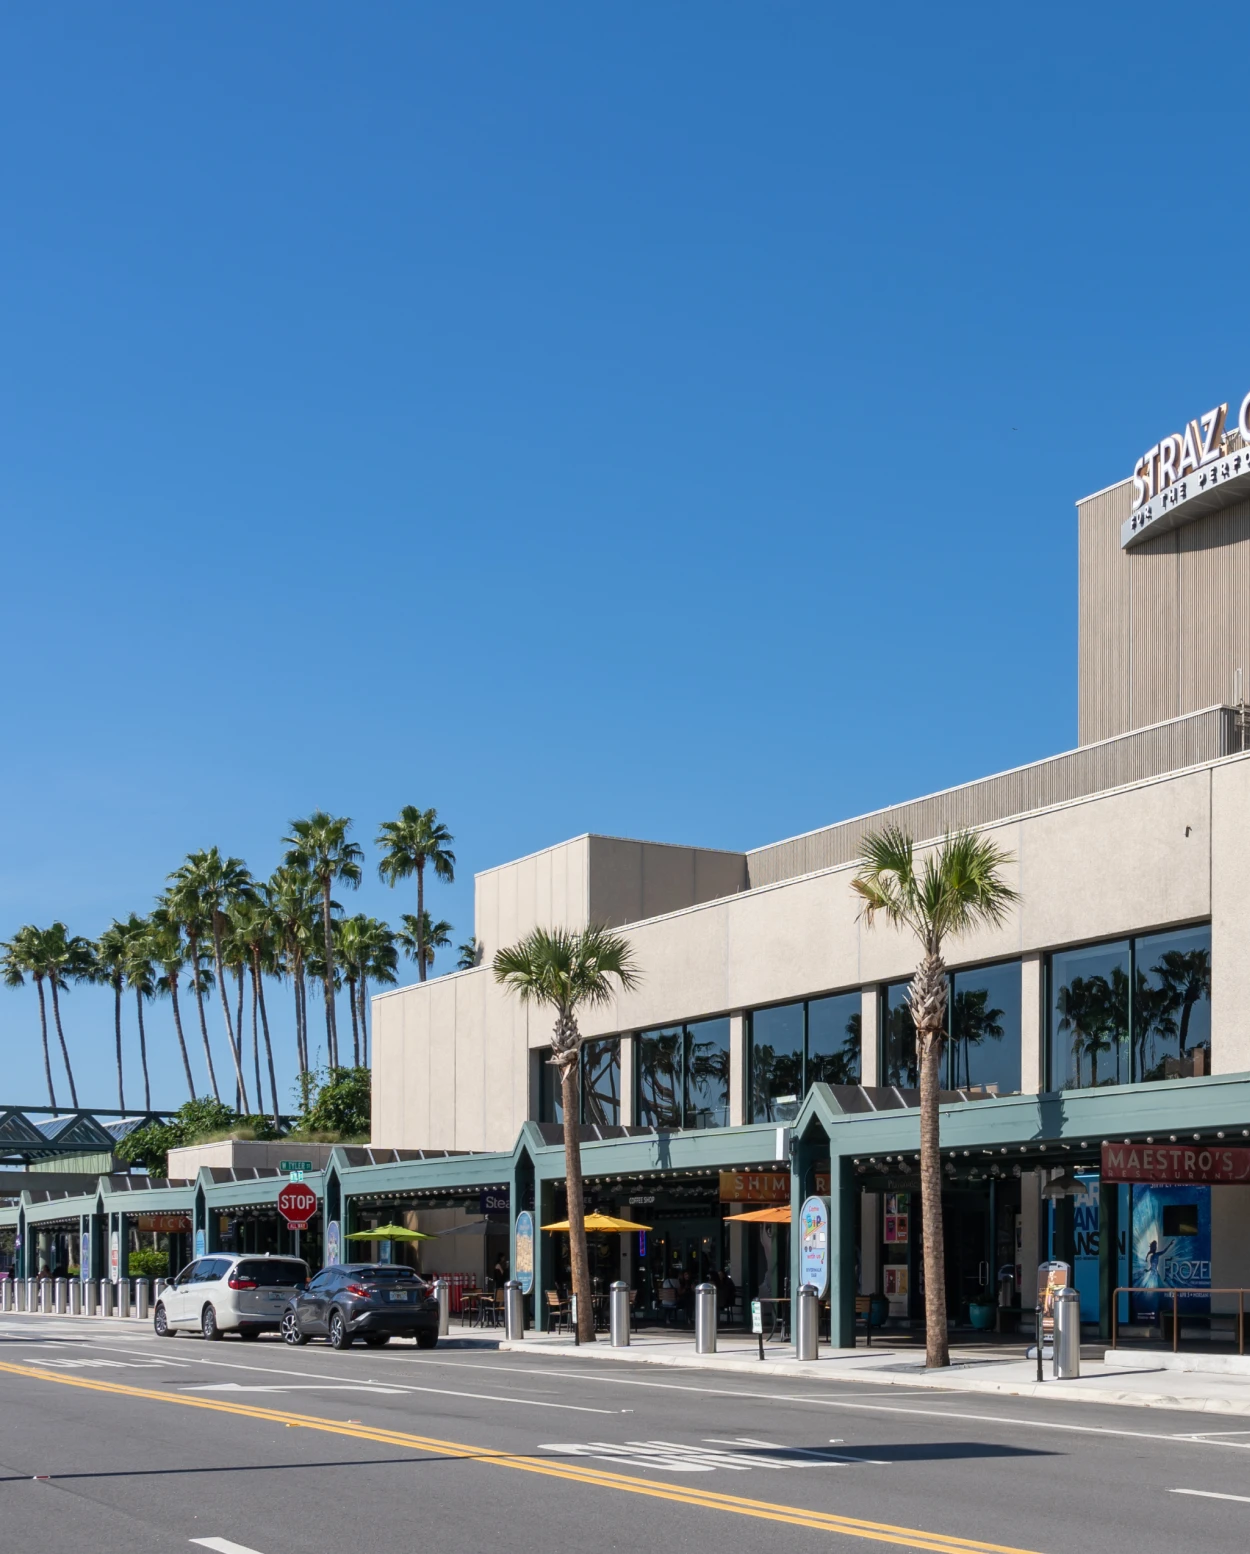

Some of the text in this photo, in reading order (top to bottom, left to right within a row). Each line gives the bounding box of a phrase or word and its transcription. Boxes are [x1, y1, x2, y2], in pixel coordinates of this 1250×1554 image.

[1132, 403, 1228, 510] STRAZ
[1130, 505, 1152, 531] FOR
[1160, 481, 1187, 507] THE
[288, 1162, 305, 1170] TYLER
[1107, 1149, 1234, 1172] MAESTRO'S
[1108, 1169, 1236, 1180] RESTAURANT
[281, 1195, 314, 1210] STOP
[628, 1196, 643, 1204] COFFEE
[23, 1358, 192, 1368] ONLY
[536, 1438, 893, 1472] ONLY
